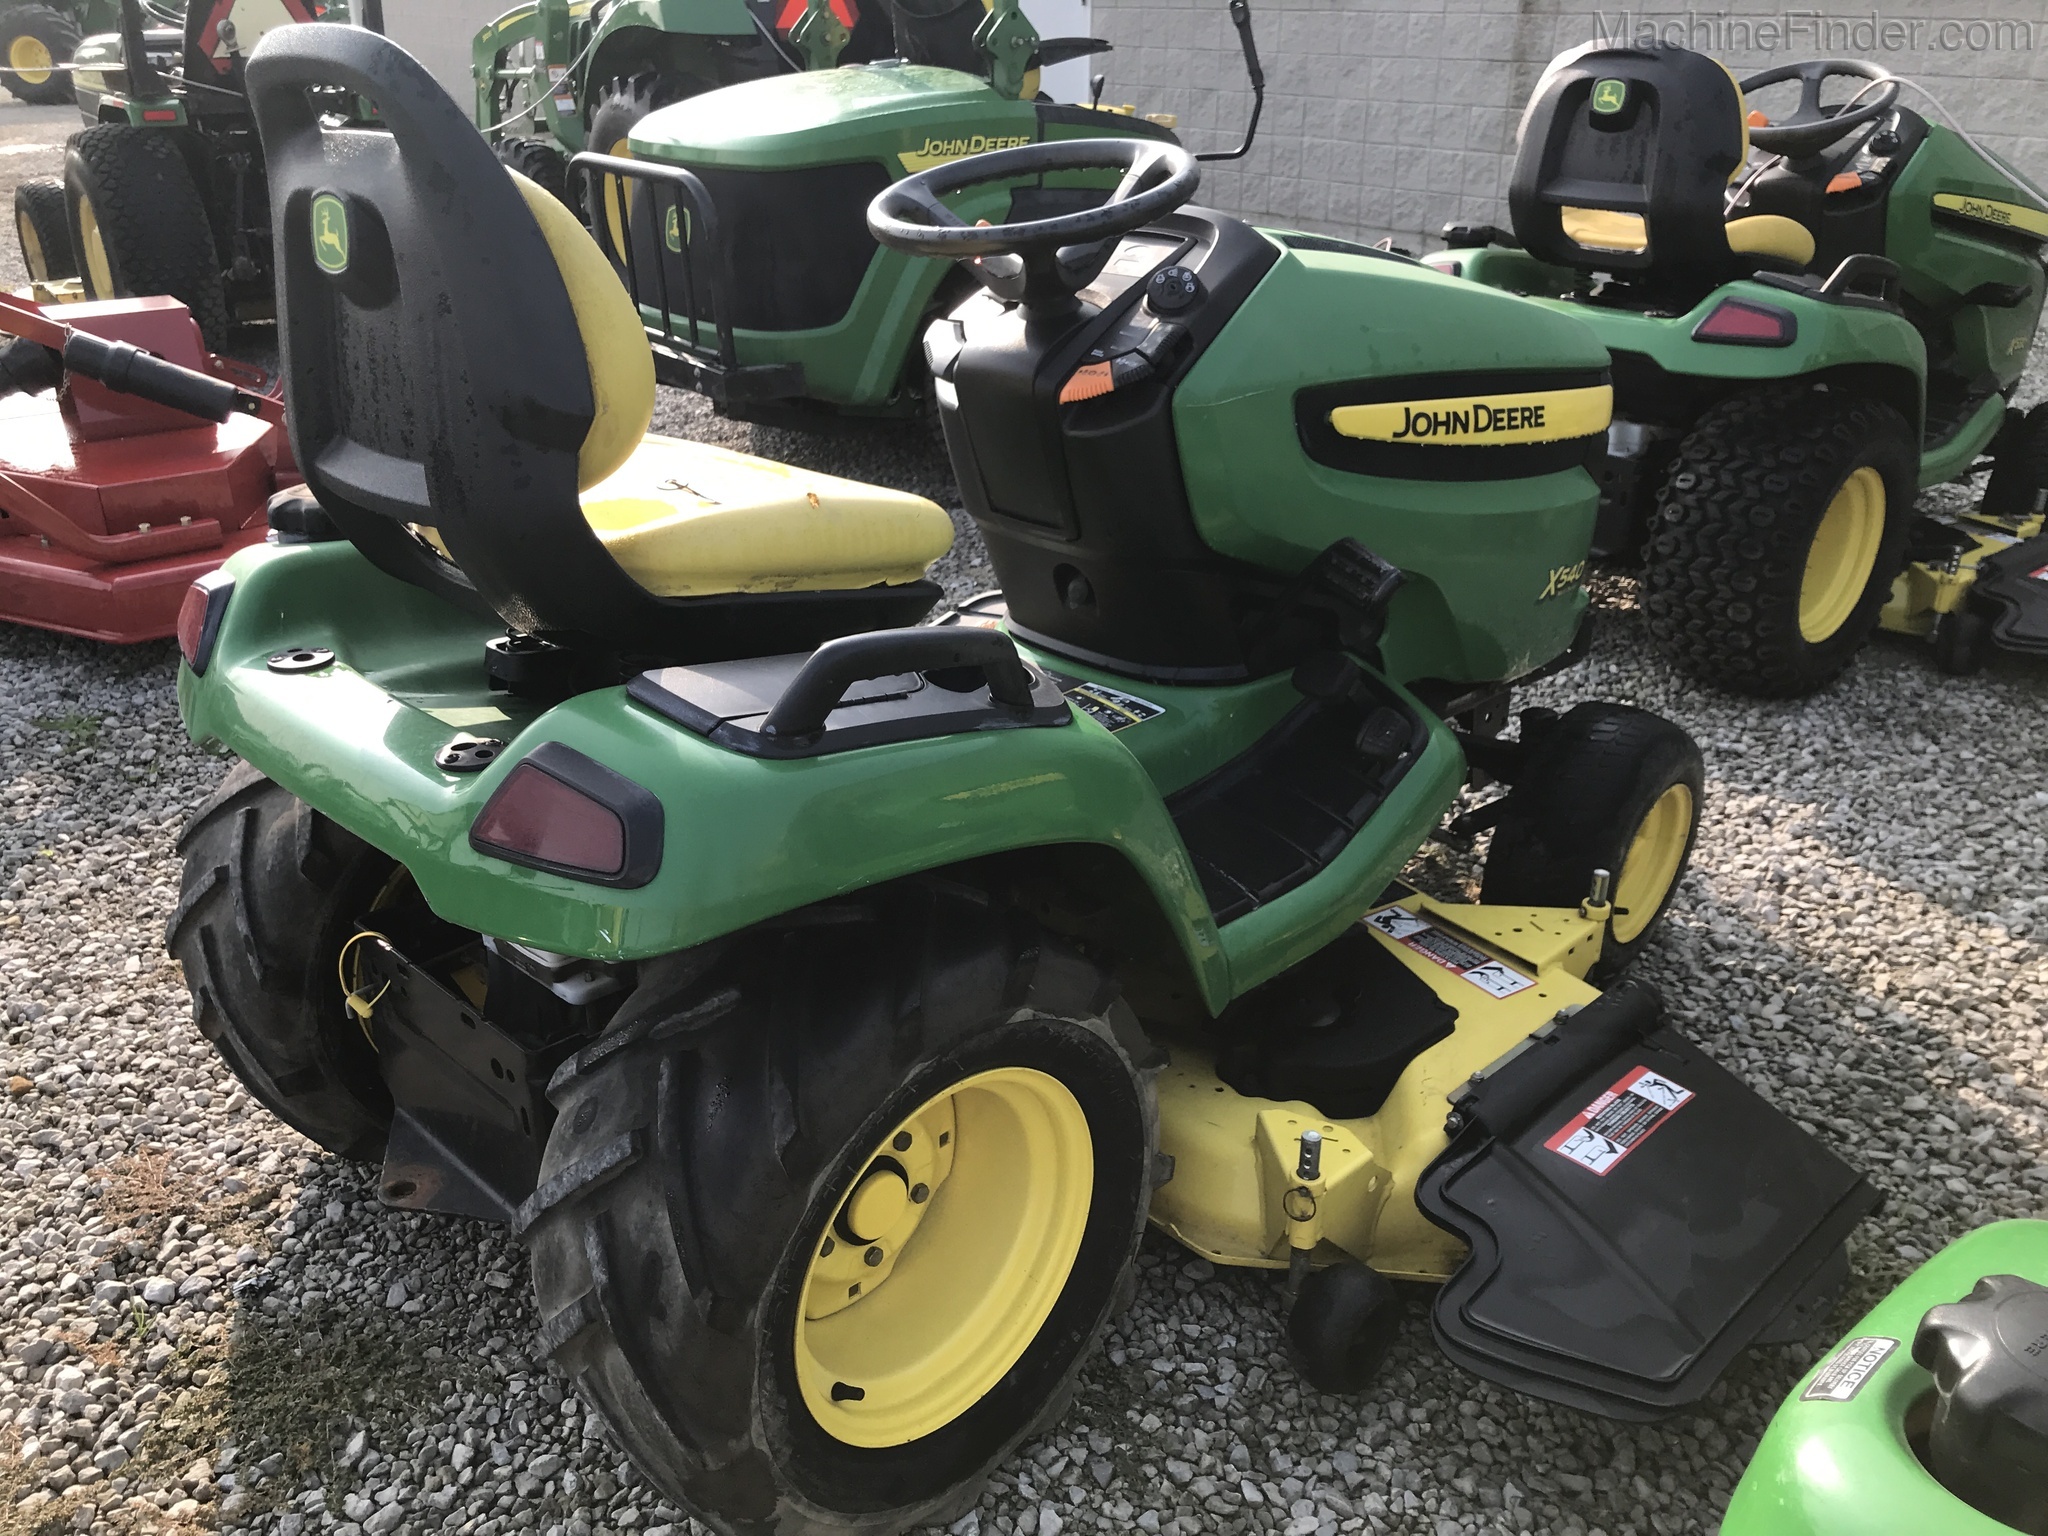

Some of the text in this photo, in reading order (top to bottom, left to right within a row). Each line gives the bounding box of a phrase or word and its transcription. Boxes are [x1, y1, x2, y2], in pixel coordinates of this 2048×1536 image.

[916, 135, 1031, 157] JOHN DEERE
[1959, 198, 2012, 225] JOHN DEERE
[1392, 404, 1545, 438] JOHN DEERE
[1539, 560, 1585, 600] X540
[1407, 941, 1446, 965] DANGER
[1587, 1091, 1619, 1116] DANGER
[1840, 1347, 1885, 1389] NOTICE
